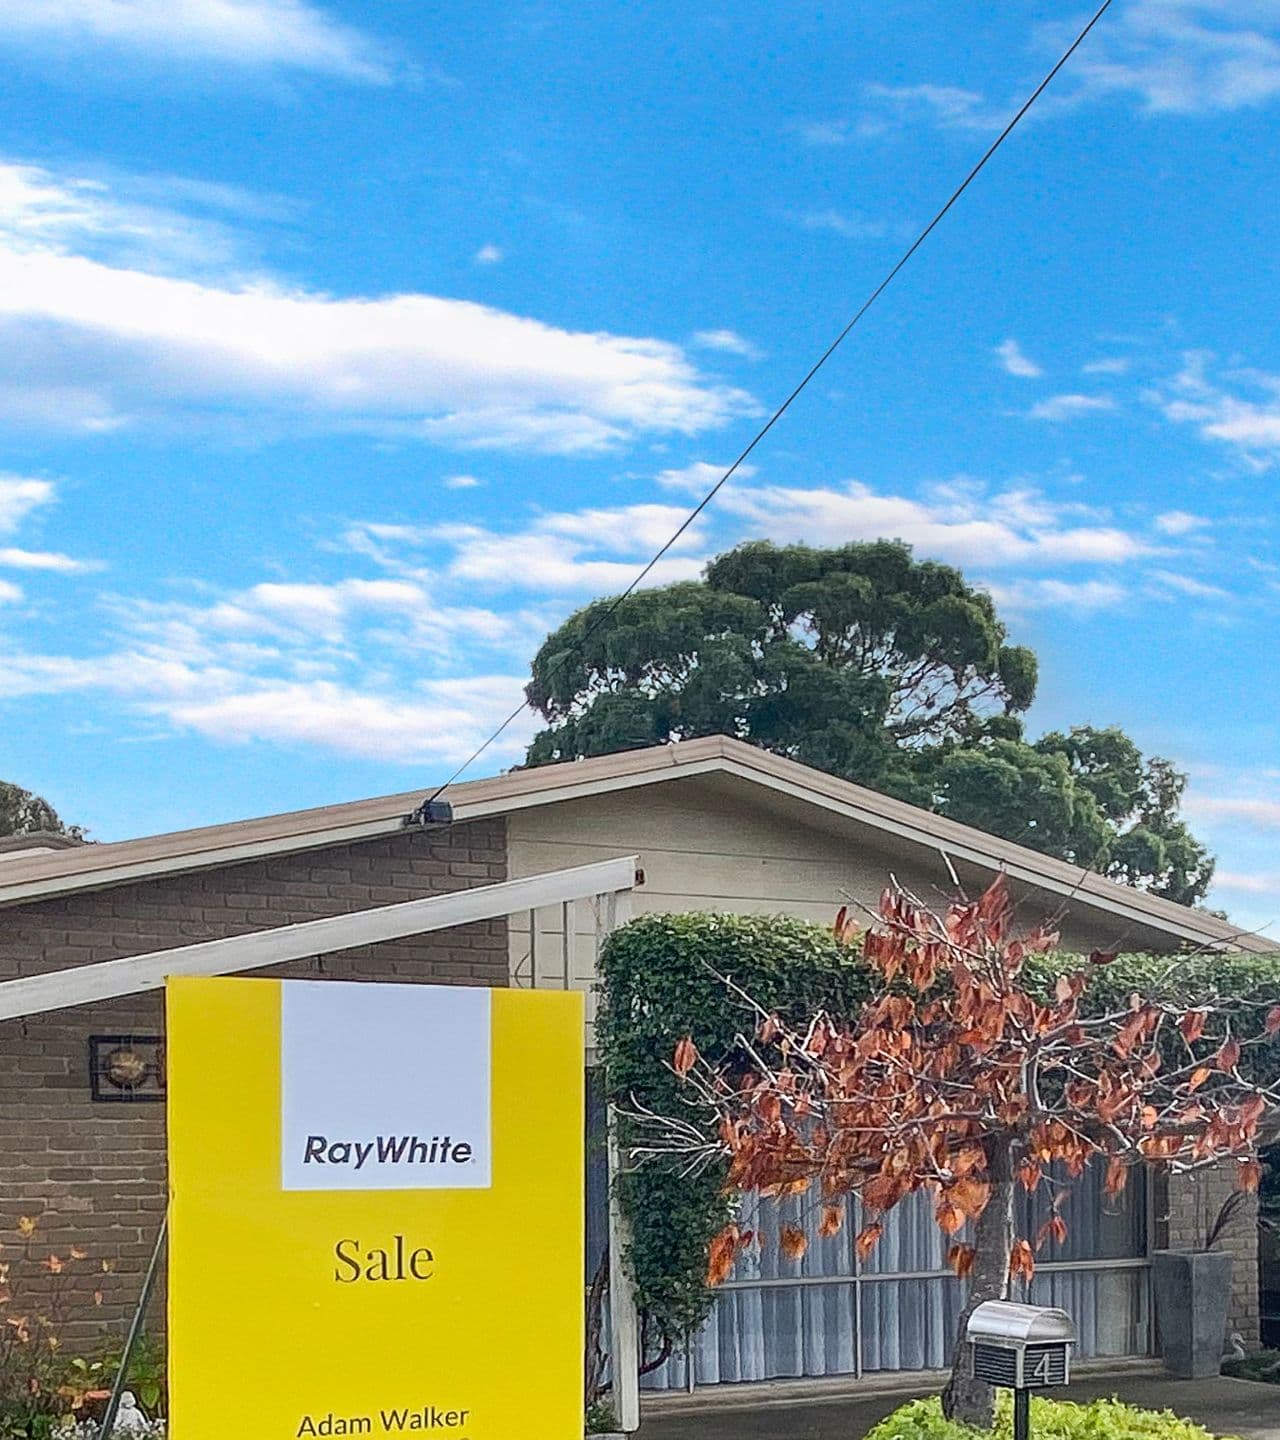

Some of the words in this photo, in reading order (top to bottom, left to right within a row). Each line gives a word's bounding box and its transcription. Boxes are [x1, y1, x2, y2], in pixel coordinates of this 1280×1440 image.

[303, 1135, 472, 1169] RayWhite
[335, 1235, 434, 1283] Sale
[1033, 1353, 1054, 1384] 4
[296, 1413, 372, 1438] Adam
[379, 1406, 470, 1431] Walker
